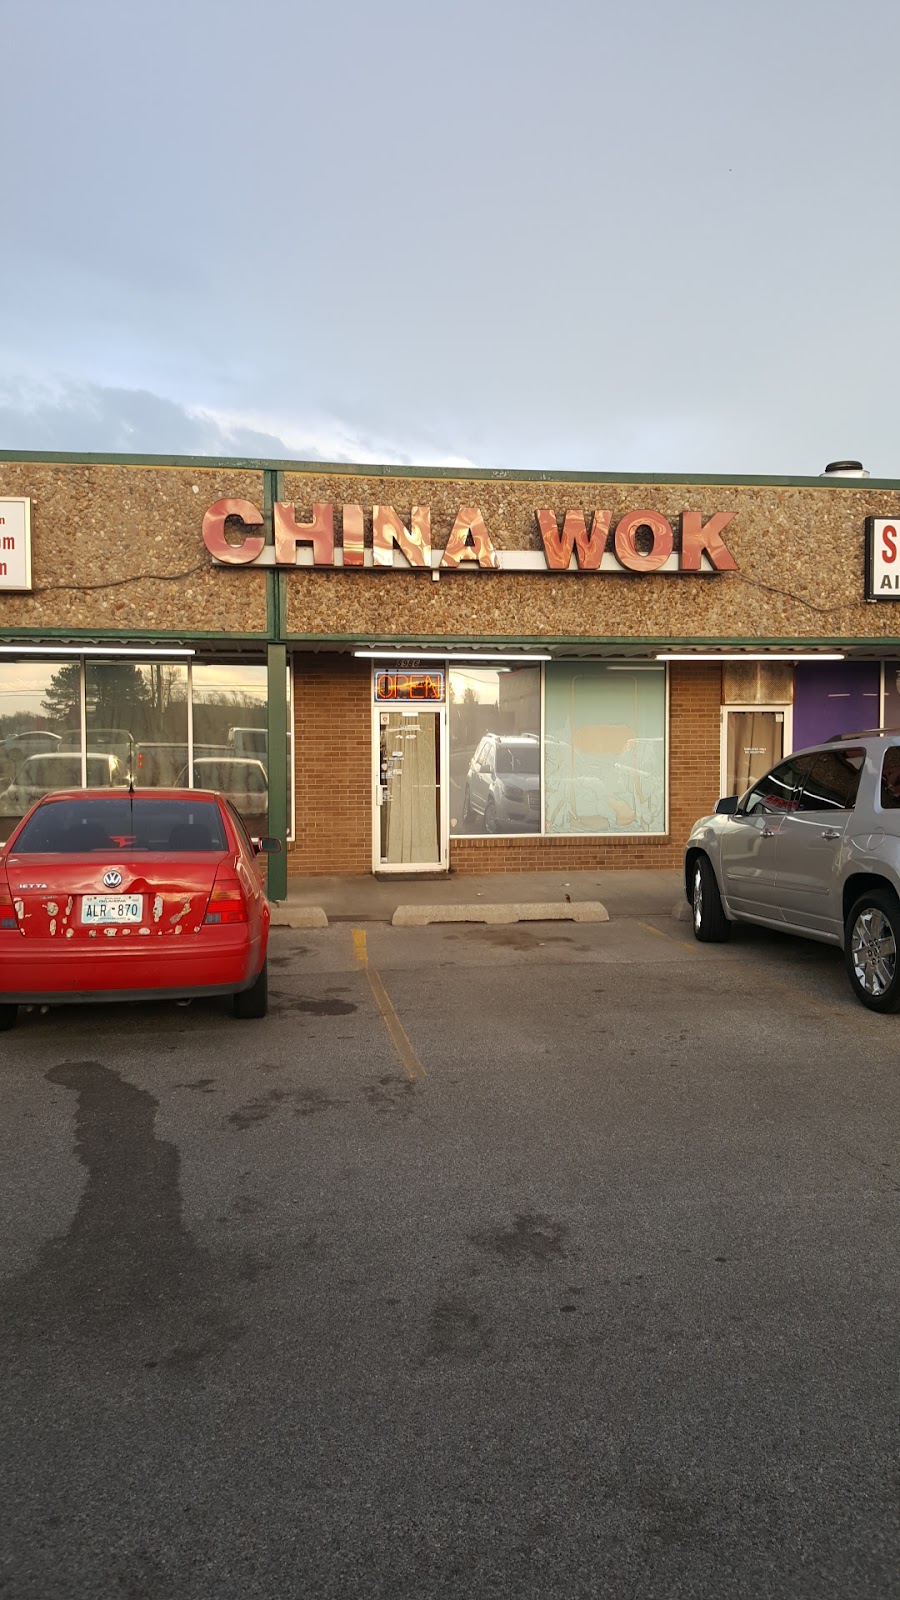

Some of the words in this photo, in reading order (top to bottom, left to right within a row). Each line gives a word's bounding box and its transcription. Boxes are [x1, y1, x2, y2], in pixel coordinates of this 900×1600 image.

[202, 498, 500, 569] CHINA
[535, 508, 740, 572] WOK
[378, 674, 440, 699] OPEN
